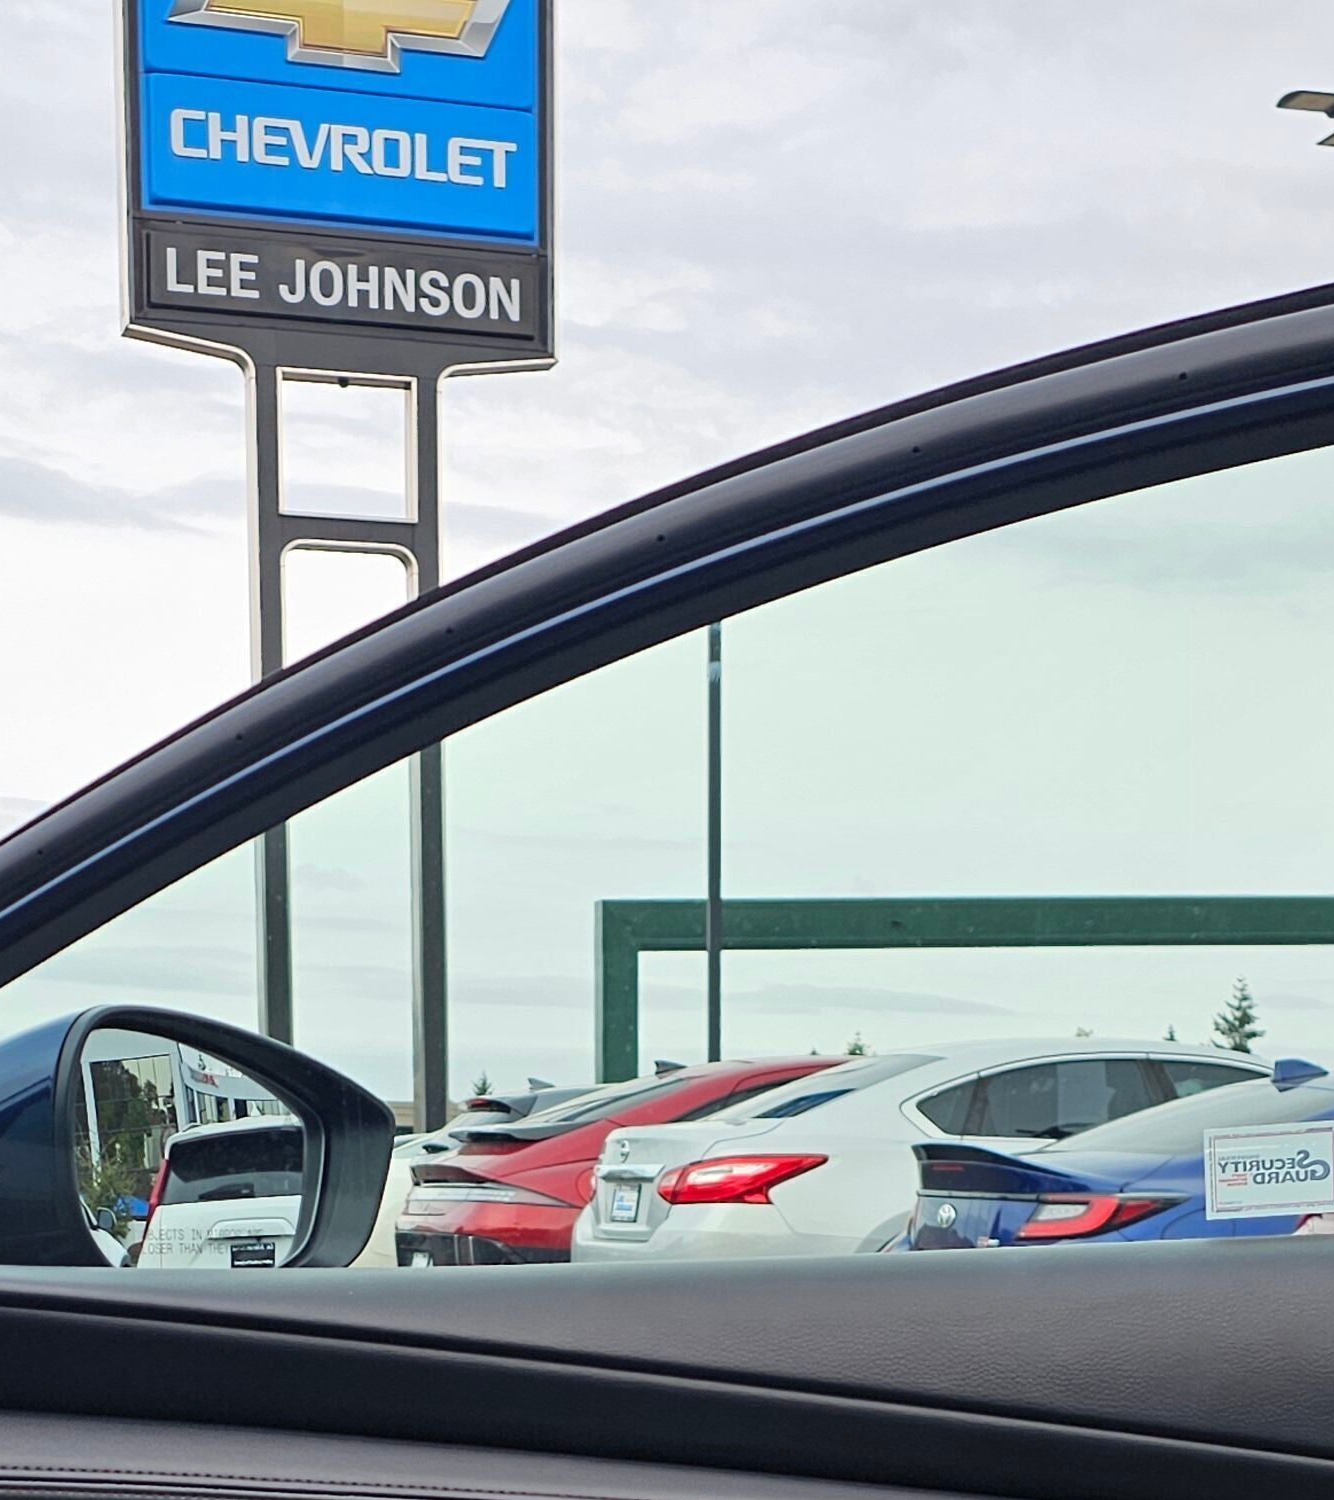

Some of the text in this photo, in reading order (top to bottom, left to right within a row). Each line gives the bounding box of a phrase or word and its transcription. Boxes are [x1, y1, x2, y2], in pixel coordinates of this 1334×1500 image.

[170, 108, 518, 189] CHEVROLET
[166, 247, 521, 322] LEE JOHNSON
